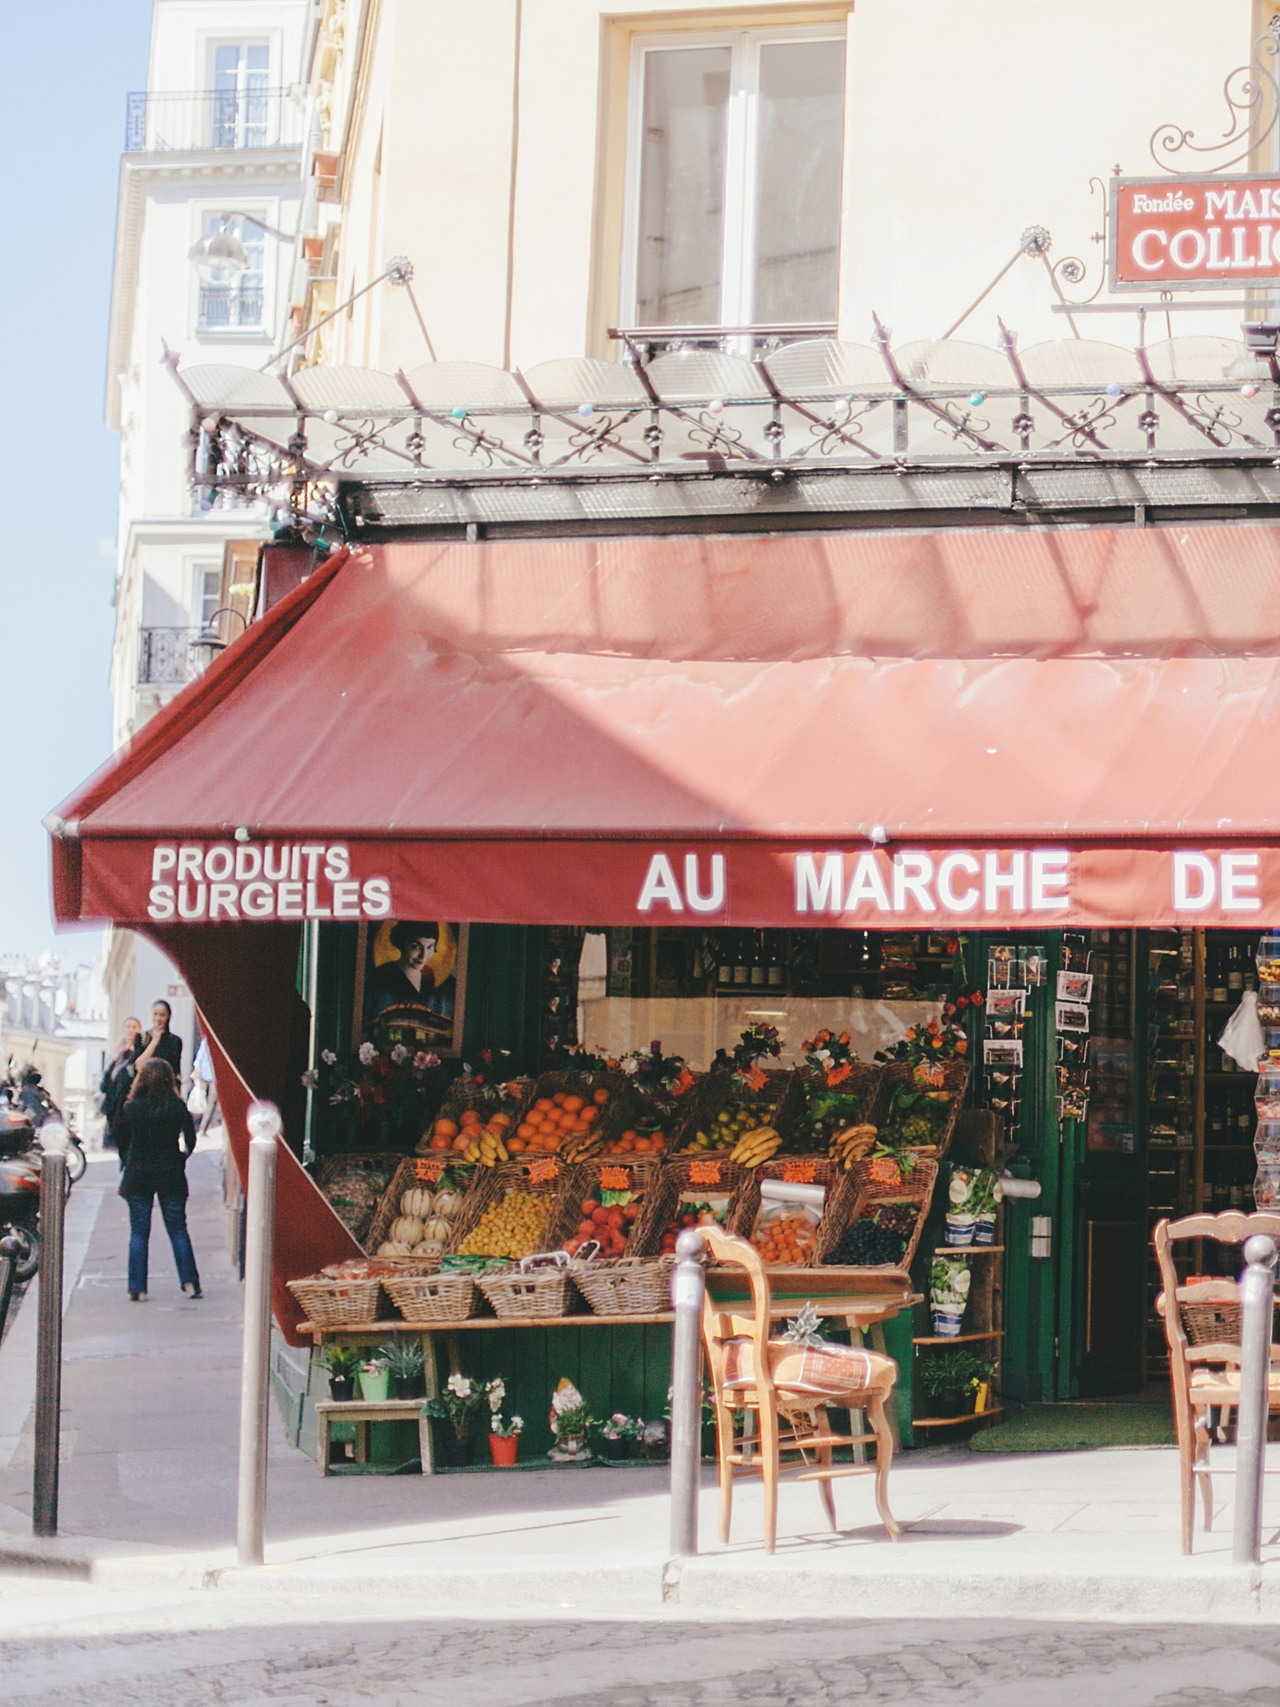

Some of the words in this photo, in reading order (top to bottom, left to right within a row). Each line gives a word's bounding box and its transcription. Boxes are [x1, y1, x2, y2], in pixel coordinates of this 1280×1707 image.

[1133, 191, 1194, 214] Fondée
[152, 846, 349, 881] PRODUITS
[637, 853, 724, 911] AU
[795, 851, 1069, 911] MARCHE
[1173, 851, 1260, 909] DE
[147, 880, 390, 919] SURGELES
